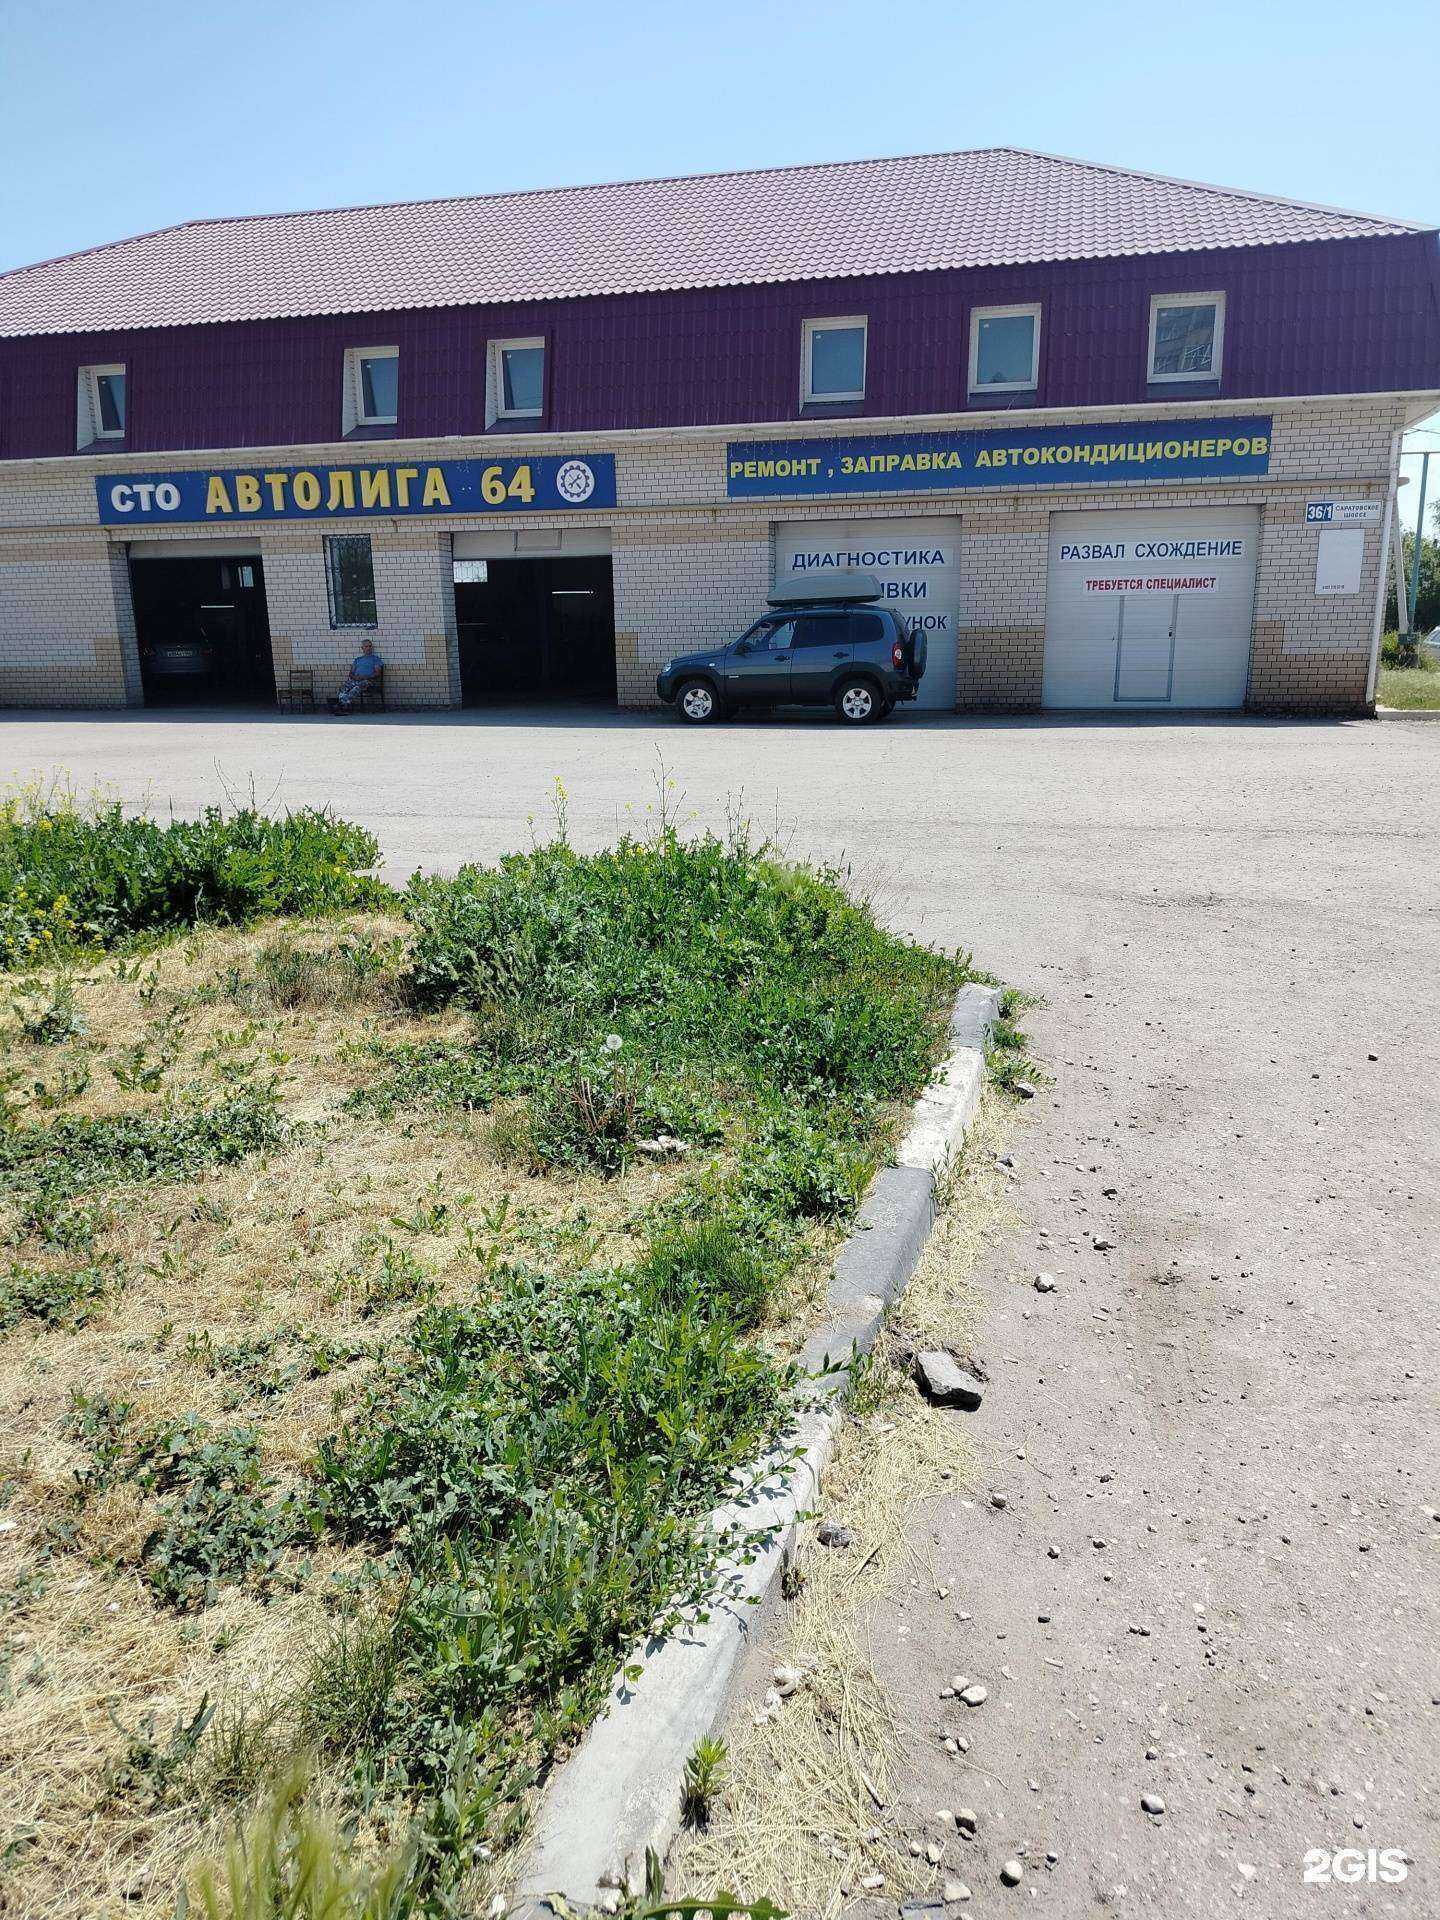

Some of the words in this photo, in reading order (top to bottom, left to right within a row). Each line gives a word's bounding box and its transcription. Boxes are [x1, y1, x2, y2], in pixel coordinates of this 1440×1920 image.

[730, 458, 822, 478] РЕМОНТ
[840, 451, 962, 474] ЗАПРАВКА
[975, 437, 1269, 468] АВТОКОНДИЦИОНЕРОВ
[110, 483, 181, 513] СТО
[205, 467, 452, 514] АВТОЛИГА
[481, 465, 536, 505] 64
[1308, 504, 1332, 520] 36/1
[792, 550, 945, 571] ДИАГНОСТИКА
[1060, 544, 1125, 560] РАЗВАЛ
[1135, 541, 1243, 559] СХОЖДЕНИЕ
[1086, 579, 1143, 591] ТРЕБУЕТСЯ
[1146, 577, 1217, 591] СПЕЦИАЛИСТ
